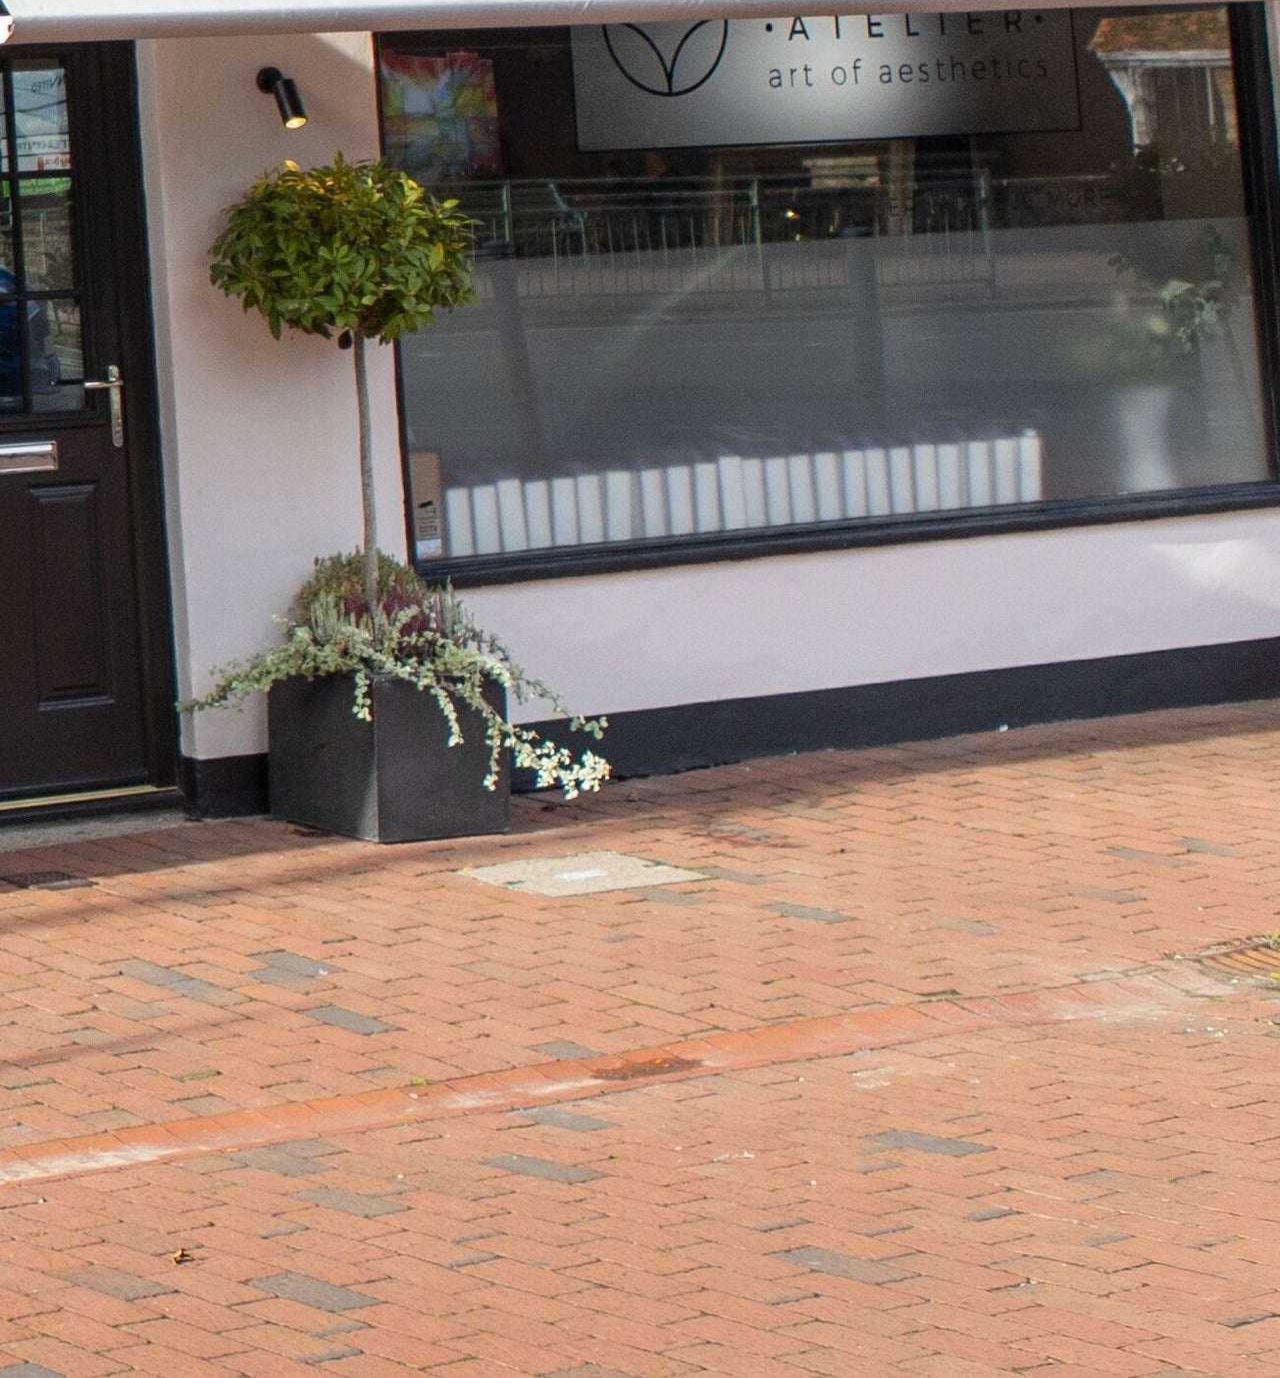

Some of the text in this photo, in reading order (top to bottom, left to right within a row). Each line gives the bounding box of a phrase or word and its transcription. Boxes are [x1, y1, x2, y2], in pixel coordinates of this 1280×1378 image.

[768, 55, 1048, 88] art of aesthetics
